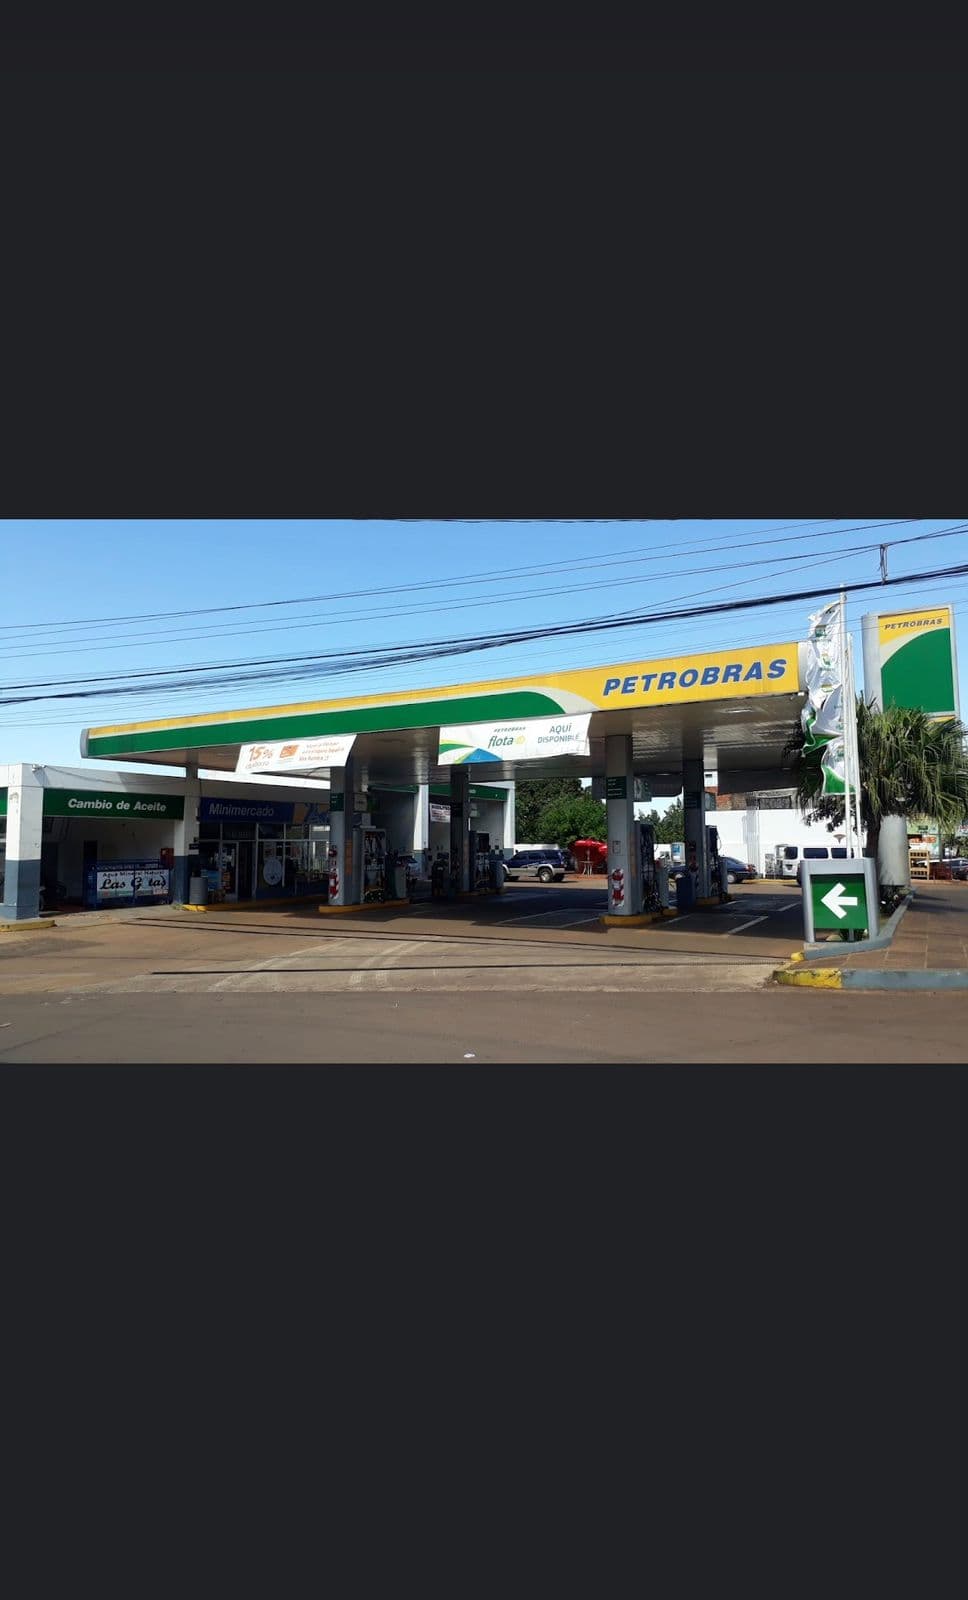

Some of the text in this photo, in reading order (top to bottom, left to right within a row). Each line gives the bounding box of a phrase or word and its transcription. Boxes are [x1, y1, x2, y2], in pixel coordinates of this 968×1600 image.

[884, 618, 943, 630] PETROBRAS
[603, 659, 787, 696] PETROBRAS
[488, 736, 514, 748] flota
[537, 733, 579, 744] DISPONIBLE
[249, 746, 273, 761] 15%
[68, 798, 167, 812] Cambio de Aceite
[209, 803, 274, 817] Minimercado
[100, 876, 166, 890] Las Gtas
